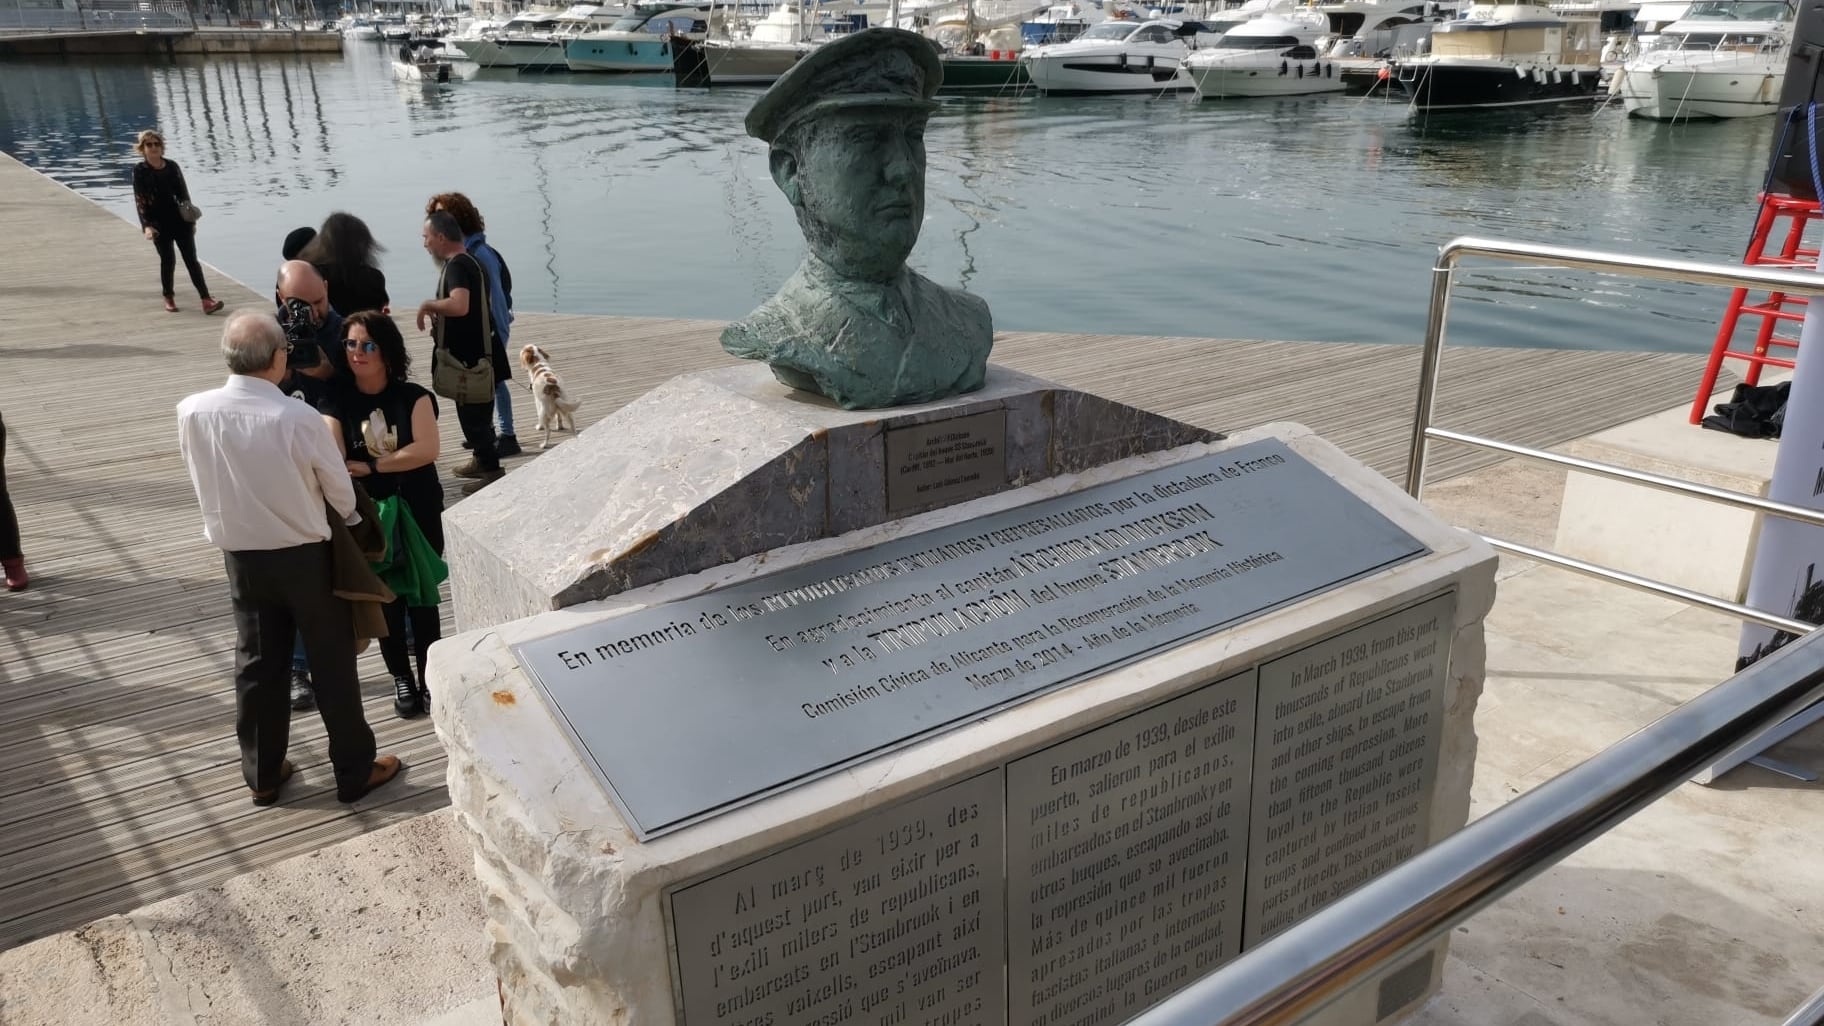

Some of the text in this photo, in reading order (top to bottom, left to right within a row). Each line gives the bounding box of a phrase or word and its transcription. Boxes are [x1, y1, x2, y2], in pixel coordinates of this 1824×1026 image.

[557, 453, 1286, 670] En memoria de las REPUBLICANOS EXILIADOS Y REPRESALIADOS por la dictadura de Franco
[765, 501, 1215, 652] En agradecimiento al capitán ARCHIBALD DICKSON
[821, 531, 1223, 680] y a la TRIPULACIÓN del buque STANBROOK
[801, 550, 1285, 719] Comisión Cívica de Alicante para la Recuperación de la Memoria Histórica
[964, 602, 1200, 691] Marzo de 2014 Año de la Memoria
[1303, 656, 1337, 684] March
[1371, 634, 1395, 656] from
[1397, 624, 1415, 646] this
[1272, 722, 1294, 747] into
[1328, 693, 1363, 722] aboard
[1366, 687, 1382, 705] the
[1385, 663, 1434, 697] Stanbrook
[1275, 640, 1437, 721] thousands Republicans went
[1051, 698, 1237, 786] En marzo de 1939, desde este
[1270, 711, 1429, 795] the coming More
[1271, 689, 1432, 770] and other escape from
[1031, 724, 1236, 825] puerto, salieron para el exilio
[1266, 757, 1424, 844] loyal the Republic were
[1268, 734, 1426, 820] than fifteen thousand citizens
[735, 803, 979, 915] Al març de des
[1030, 817, 1080, 850] miles
[1091, 804, 1110, 824] de
[1031, 776, 1232, 878] embarcados en Stanbrook en
[1031, 800, 1231, 904] otros buques, escapando así de
[1265, 776, 1421, 867] captured by Italian fascist
[711, 839, 961, 957] d'aquest port, van eixir per
[1031, 850, 1229, 957] Más de quince mil fueron
[1031, 875, 1228, 983] apresados por las tropas
[1051, 879, 1112, 922] represión
[1119, 868, 1141, 891] que
[1149, 858, 1162, 876] se
[713, 946, 769, 989] l'exili
[781, 922, 838, 959] milers
[849, 907, 870, 929] de
[716, 964, 809, 1018] embarcats
[819, 951, 840, 972] en
[849, 903, 941, 960] l'Stanbrook
[962, 889, 980, 908] en
[869, 931, 943, 979] escapant
[953, 909, 982, 941] així
[1031, 899, 1225, 1008] fascistas italianas internados
[1051, 985, 1103, 1021] diversos
[1106, 959, 1150, 992] lugares
[1152, 950, 1168, 969] de
[1144, 940, 1223, 996] Guerra Civil
[861, 986, 889, 1013] que
[918, 987, 945, 1011] van
[956, 970, 981, 993] ser
